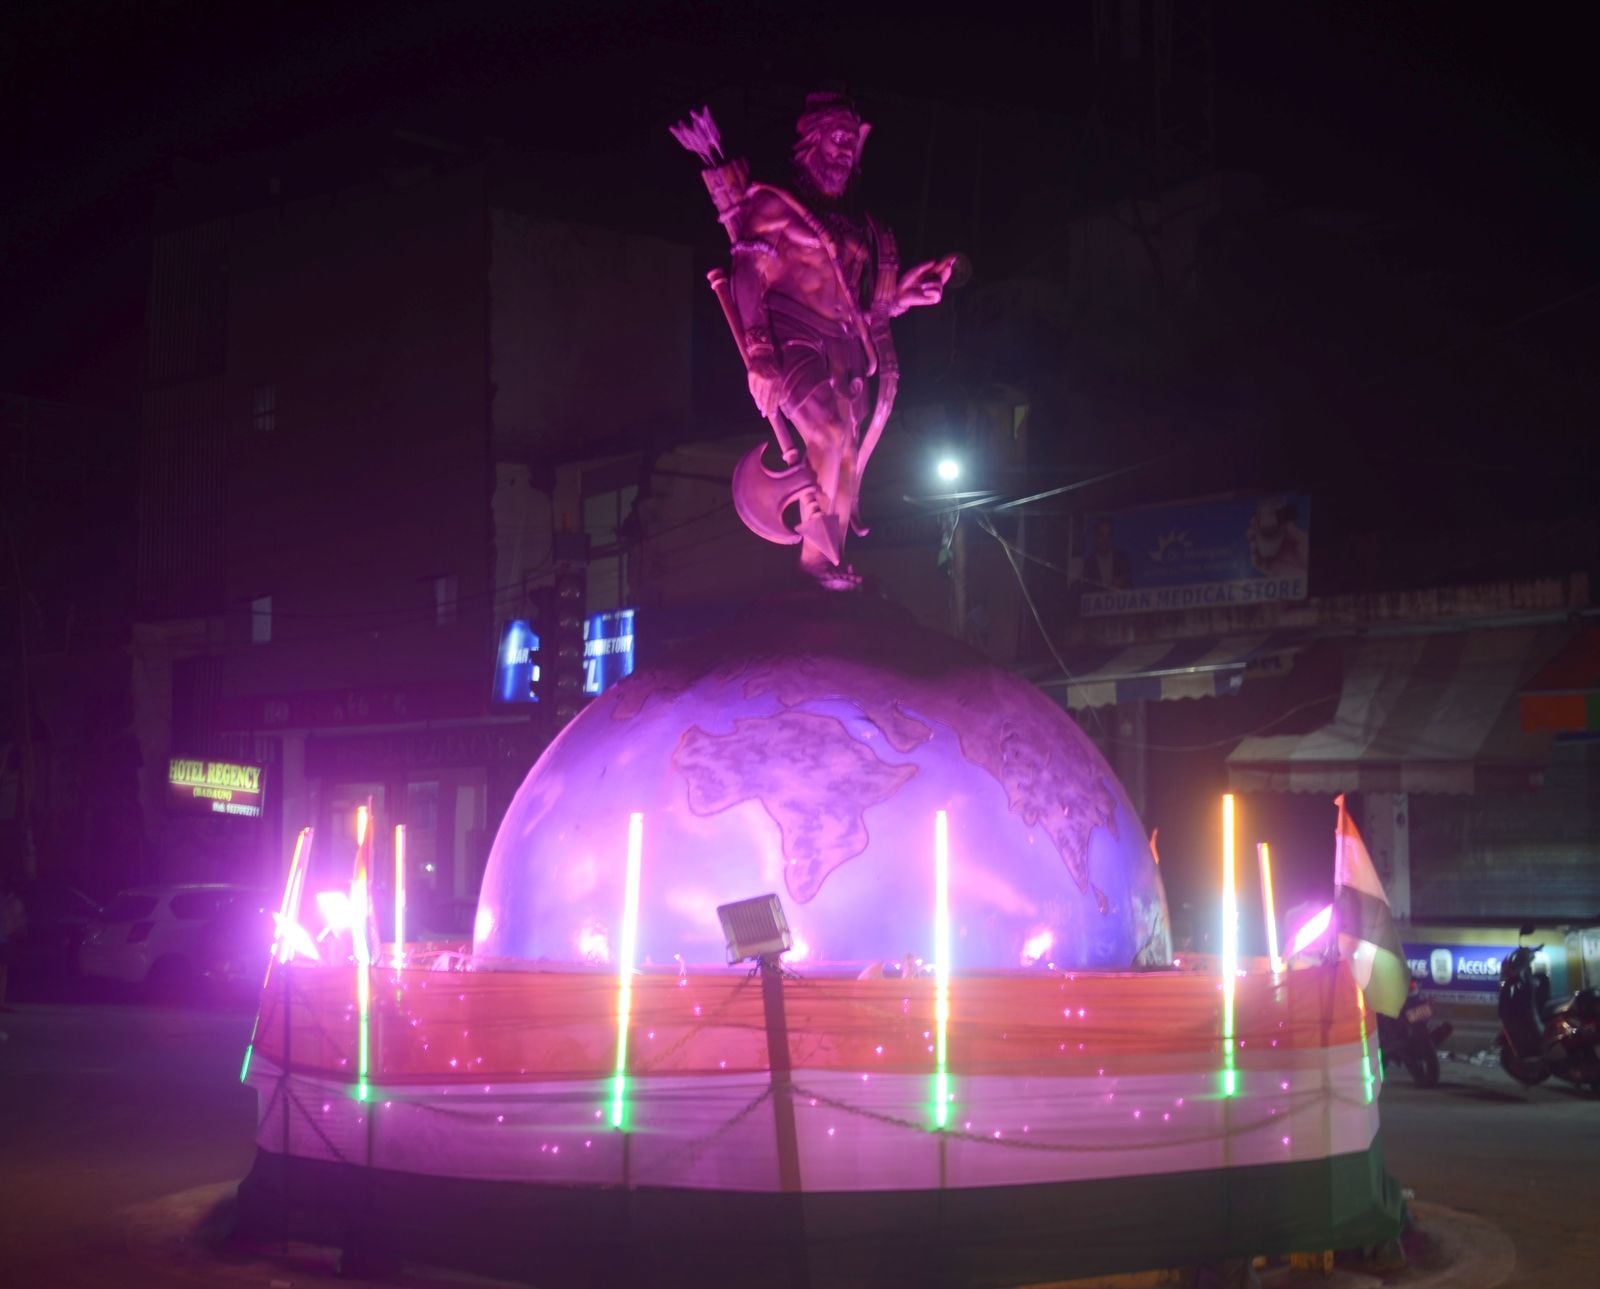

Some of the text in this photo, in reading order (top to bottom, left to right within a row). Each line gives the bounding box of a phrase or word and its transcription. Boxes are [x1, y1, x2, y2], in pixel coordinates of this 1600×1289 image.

[1156, 583, 1234, 608] MEDICAL
[1241, 577, 1301, 600] STORE
[170, 759, 261, 791] HOTEL REGENCY
